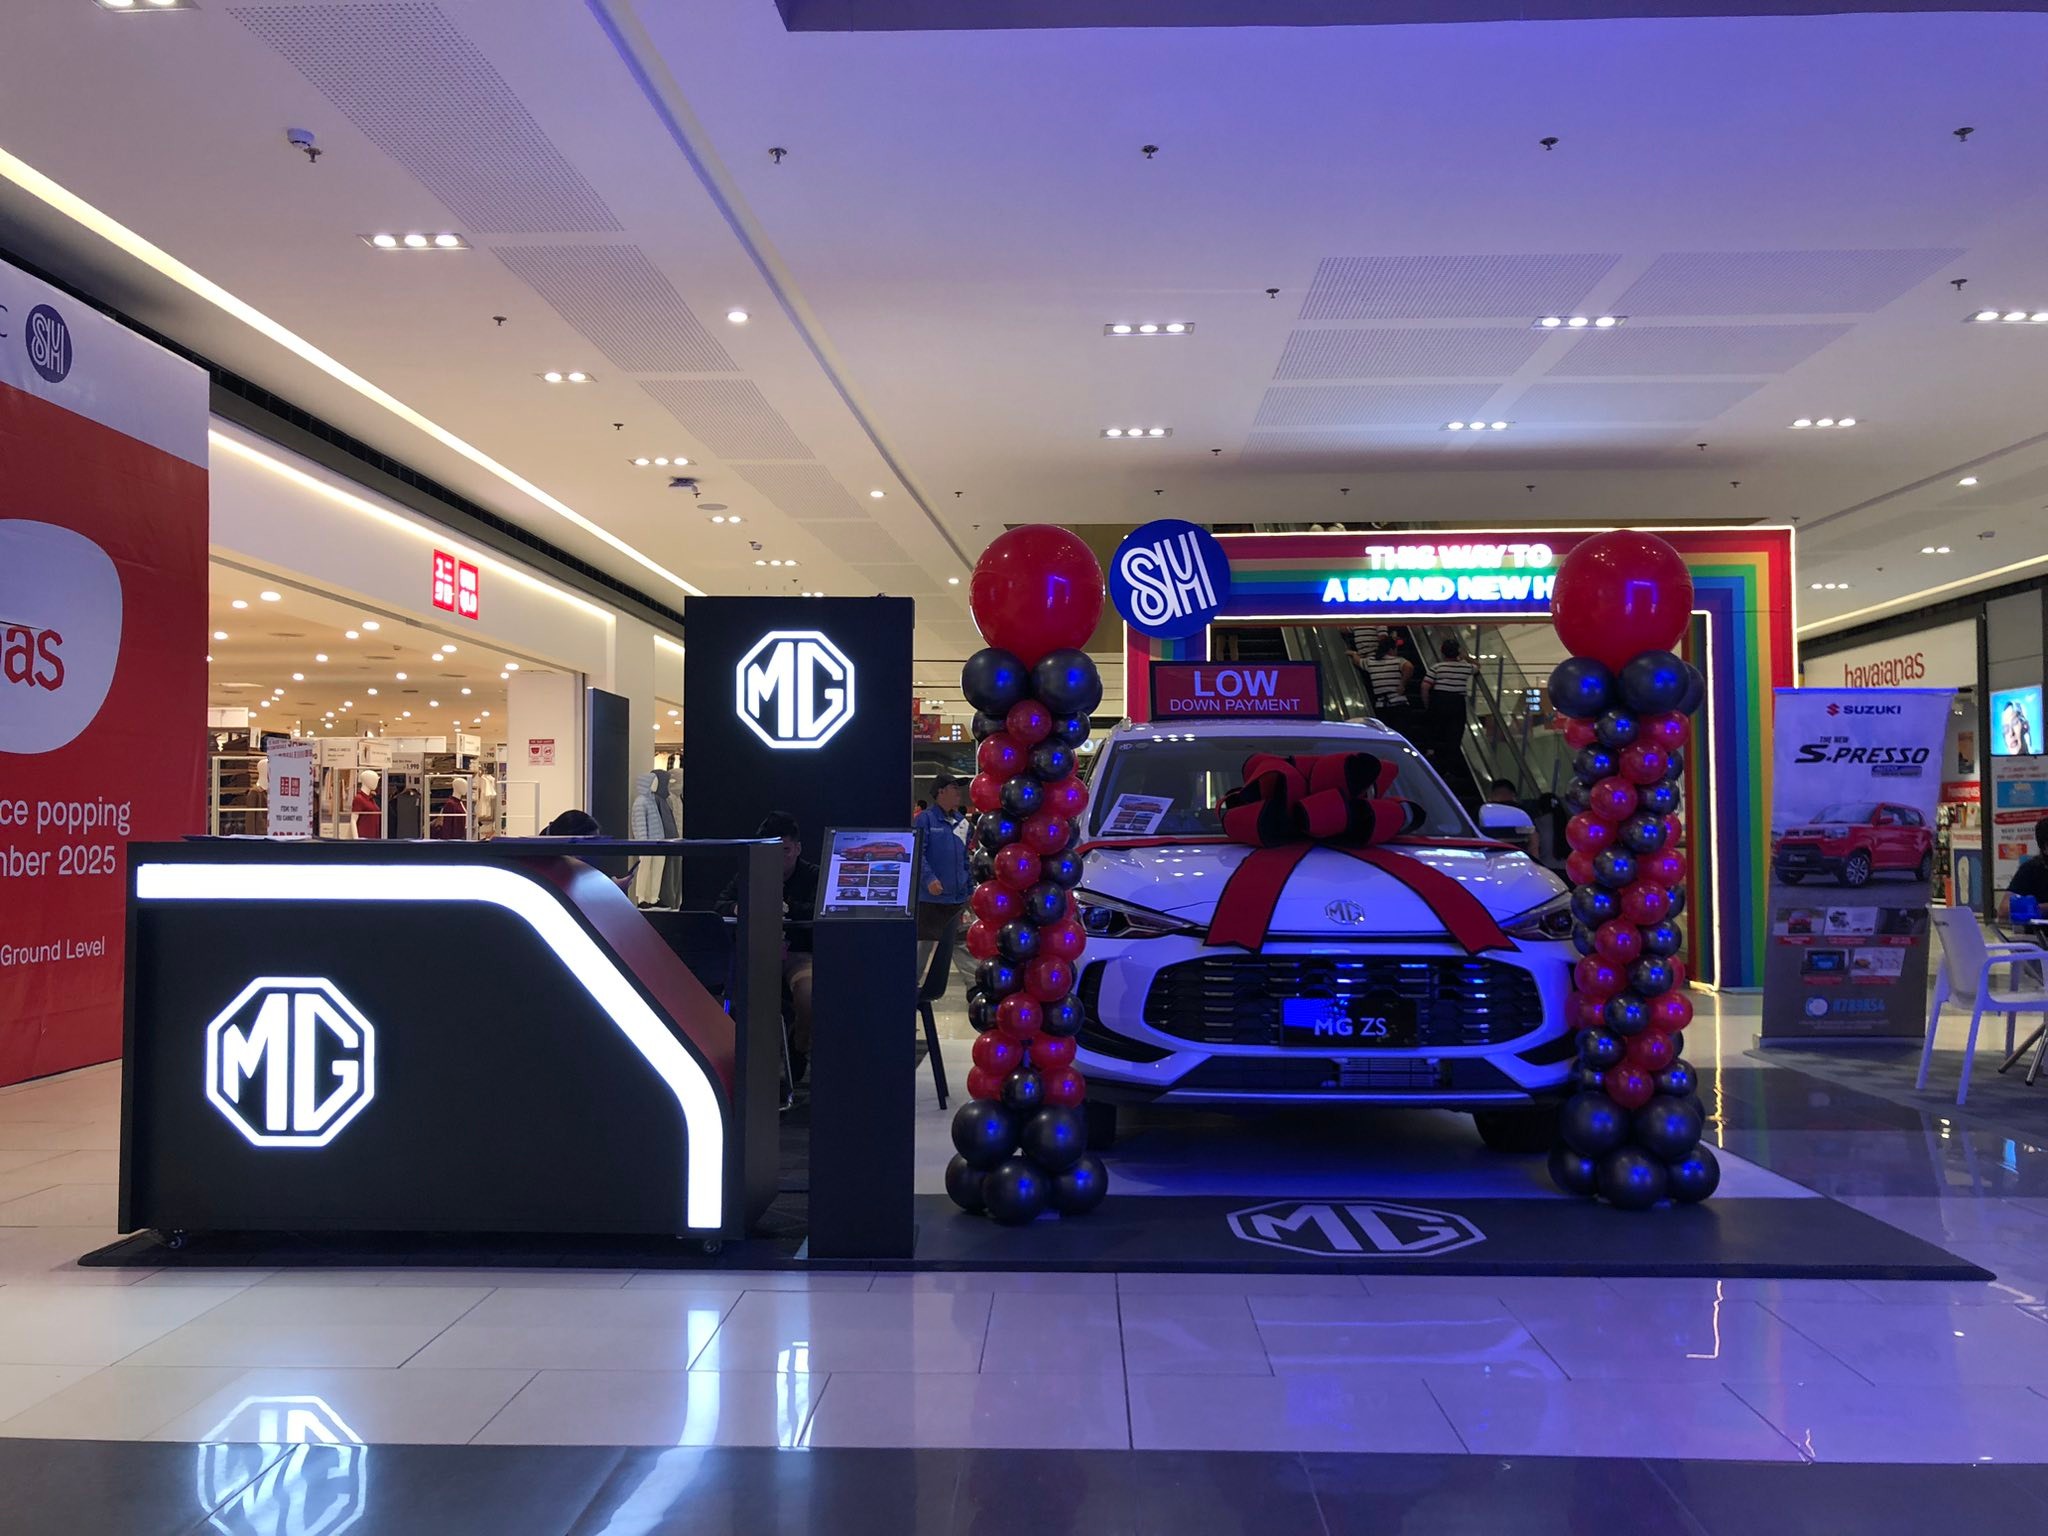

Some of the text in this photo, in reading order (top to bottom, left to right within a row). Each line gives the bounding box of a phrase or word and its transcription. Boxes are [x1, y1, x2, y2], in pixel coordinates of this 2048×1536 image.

[1365, 543, 1553, 570] THIS WAY TO
[1120, 530, 1218, 627] SM
[1322, 578, 1345, 602] A
[1347, 576, 1456, 602] BRAND
[1458, 575, 1532, 601] NEW
[0, 627, 64, 691] as
[1844, 652, 1925, 688] havaianas
[748, 642, 844, 738] MG
[1194, 670, 1279, 697] LOW
[1170, 699, 1300, 712] DOWN PAYMENT
[1843, 705, 1902, 715] SUZUKI
[0, 796, 131, 836] ce popping
[58, 845, 116, 876] 2025
[1, 936, 106, 967] Ground Level
[1314, 1018, 1388, 1036] MG ZS
[223, 993, 360, 1132] MG
[1251, 1204, 1460, 1251] MG
